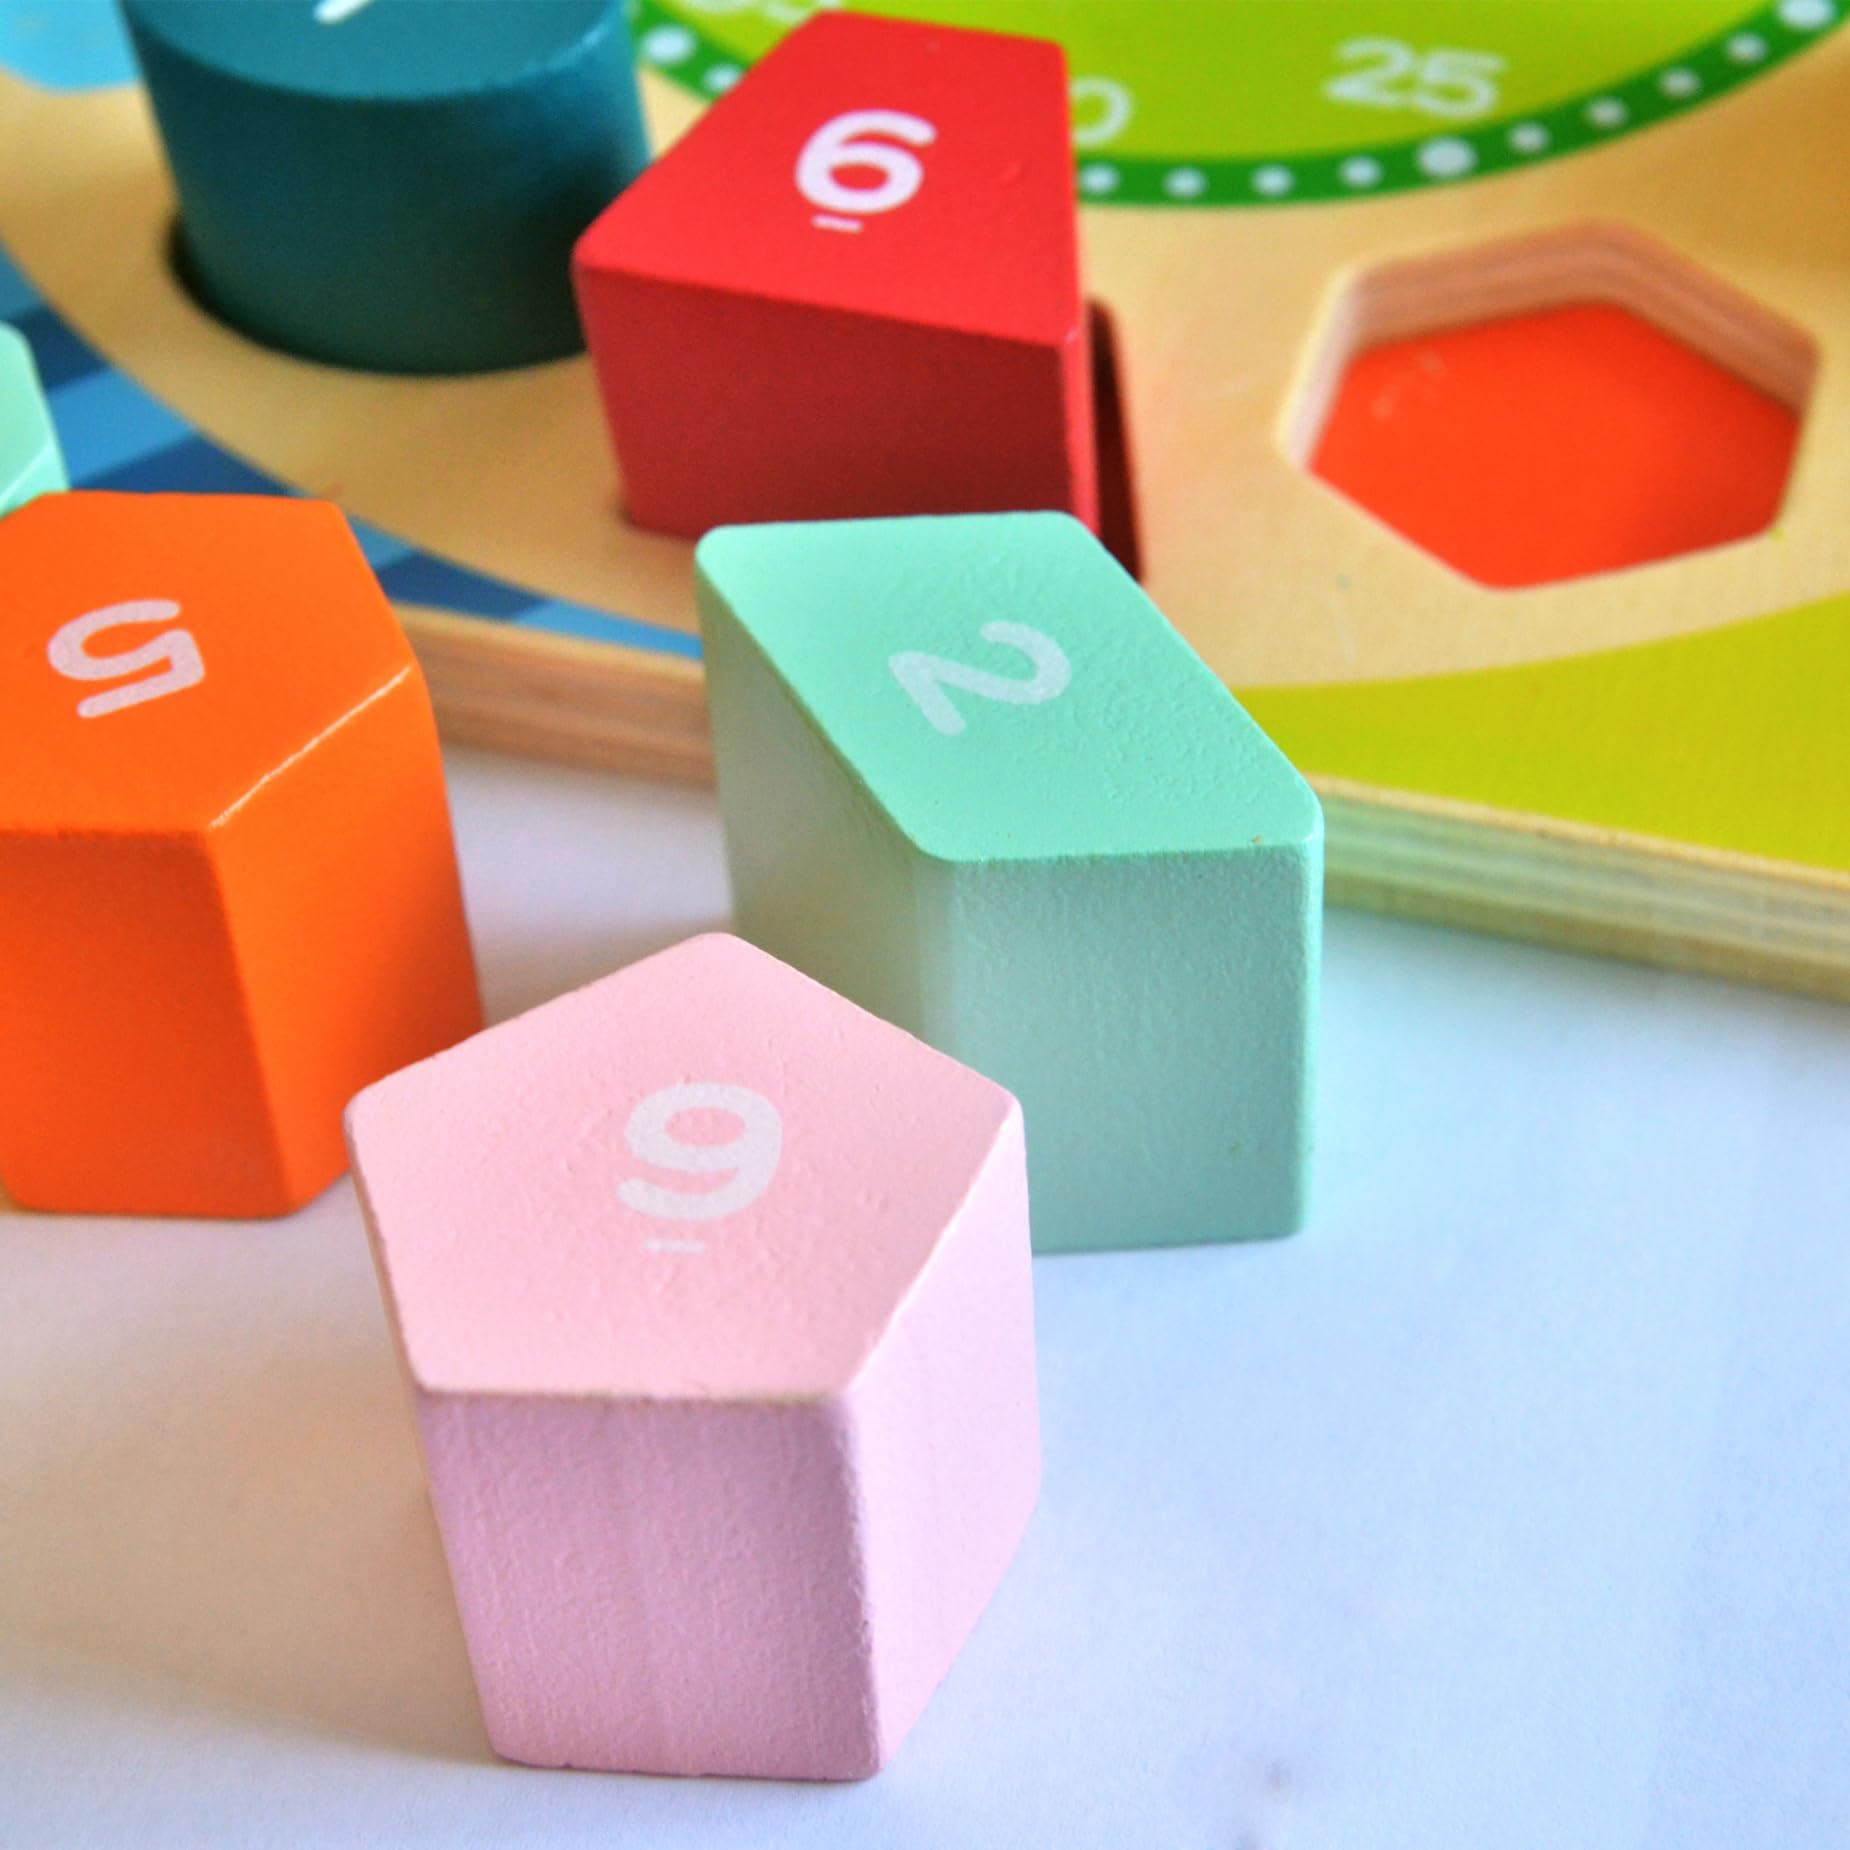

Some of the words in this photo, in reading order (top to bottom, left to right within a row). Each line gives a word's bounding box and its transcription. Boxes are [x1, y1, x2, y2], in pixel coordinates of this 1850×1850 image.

[1325, 36, 1508, 119] 25
[795, 110, 936, 214] 6
[47, 598, 205, 718] 5
[887, 619, 1072, 737] 2
[617, 1082, 783, 1222] 9
